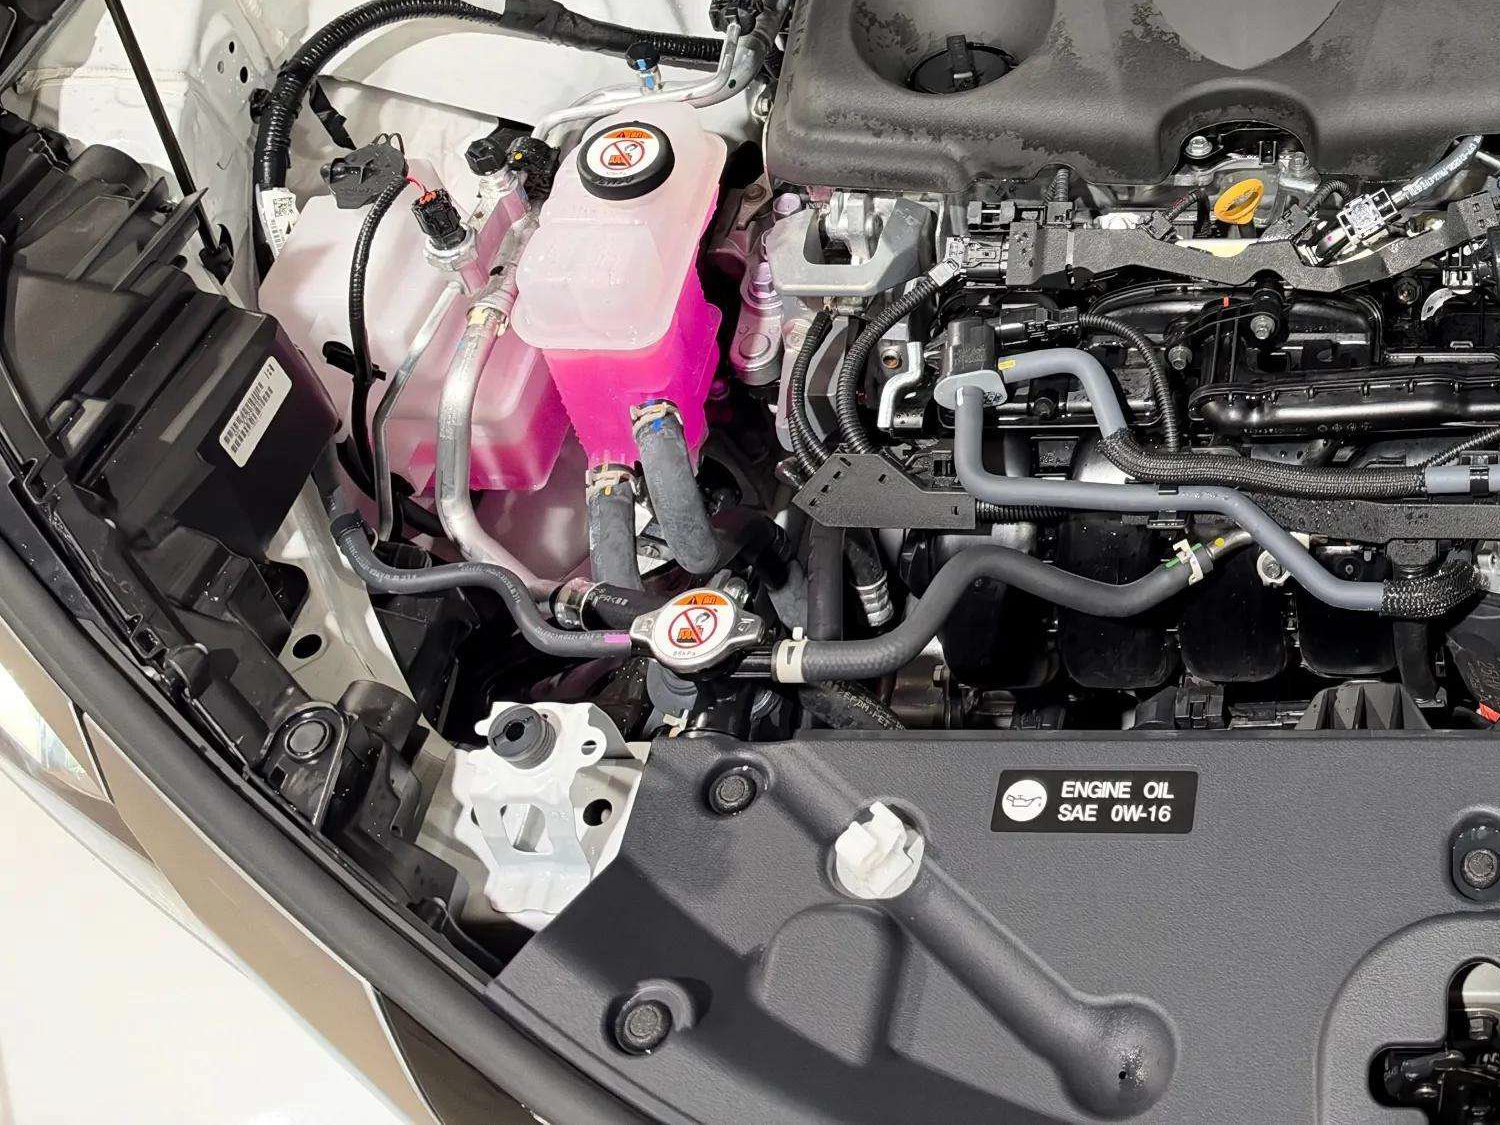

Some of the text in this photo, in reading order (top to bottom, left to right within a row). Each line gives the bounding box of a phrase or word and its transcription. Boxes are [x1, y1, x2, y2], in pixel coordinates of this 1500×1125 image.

[1061, 780, 1174, 799] ENGINE OIL
[1057, 804, 1172, 822] SAE 0W-16
